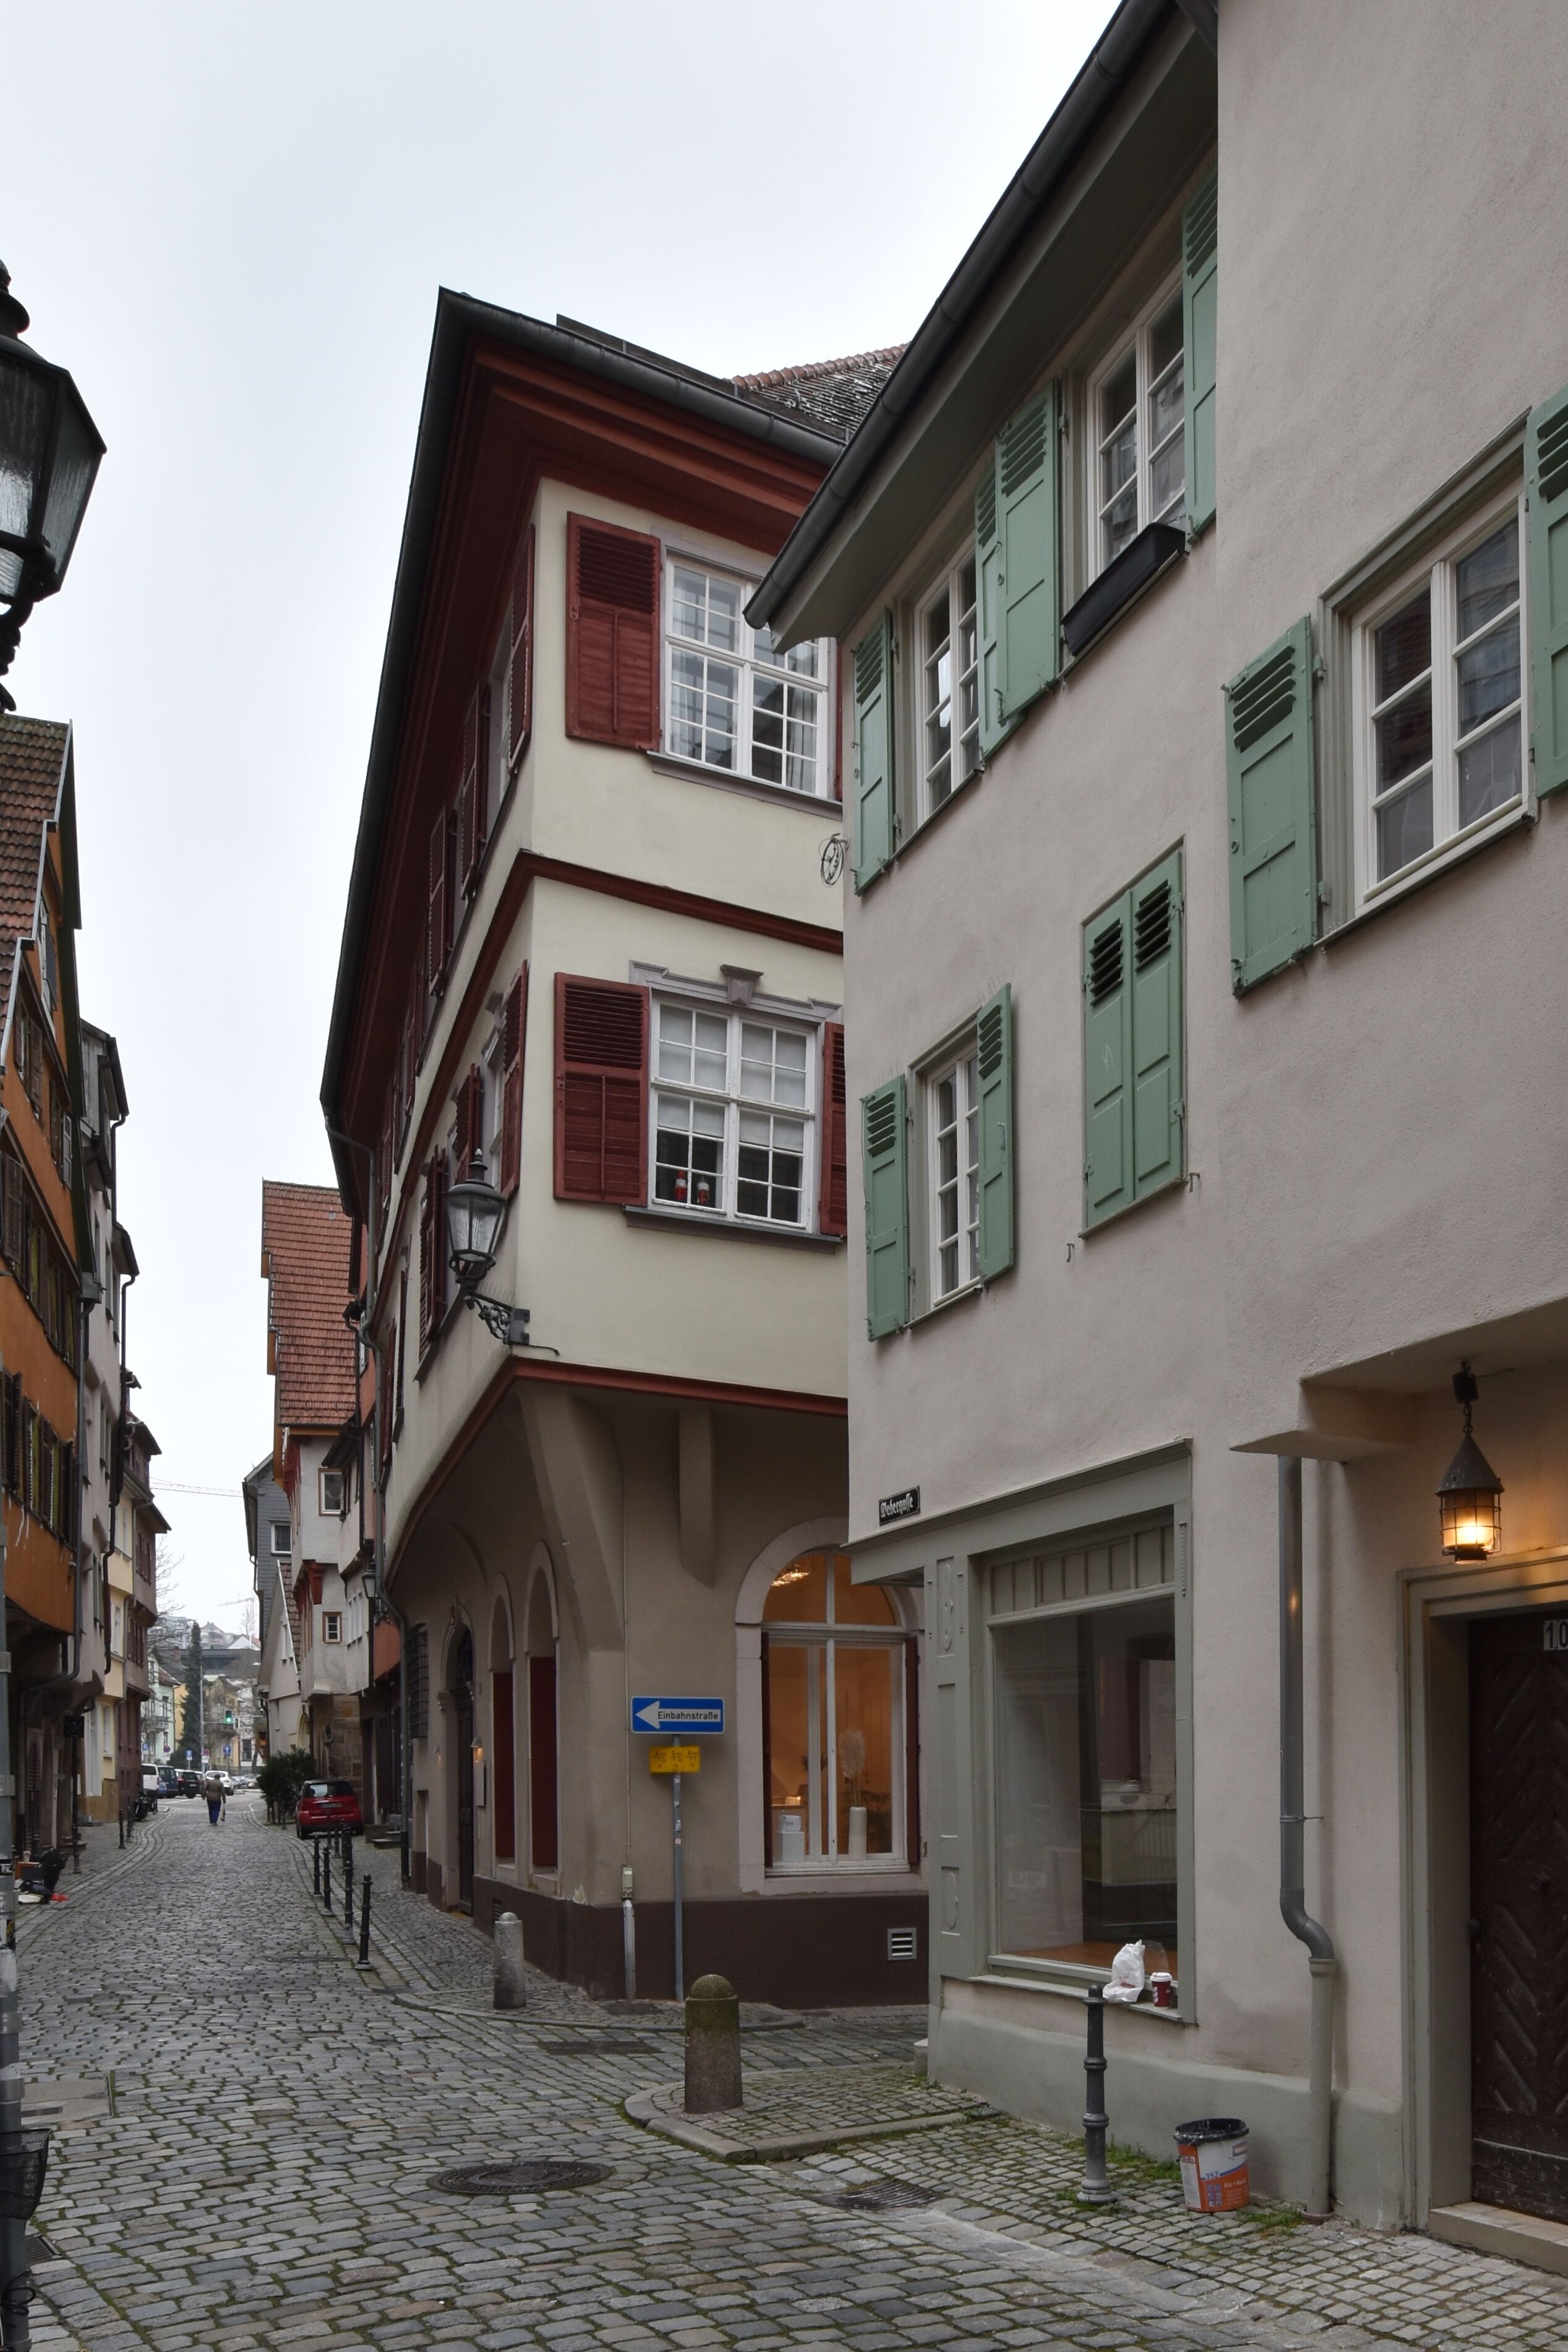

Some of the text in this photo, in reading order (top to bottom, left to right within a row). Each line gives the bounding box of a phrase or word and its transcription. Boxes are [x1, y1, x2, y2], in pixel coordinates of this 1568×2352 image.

[1546, 1619, 1568, 1648] 10
[658, 1711, 718, 1720] Einbahnstraße
[1205, 2171, 1219, 2179] 352
